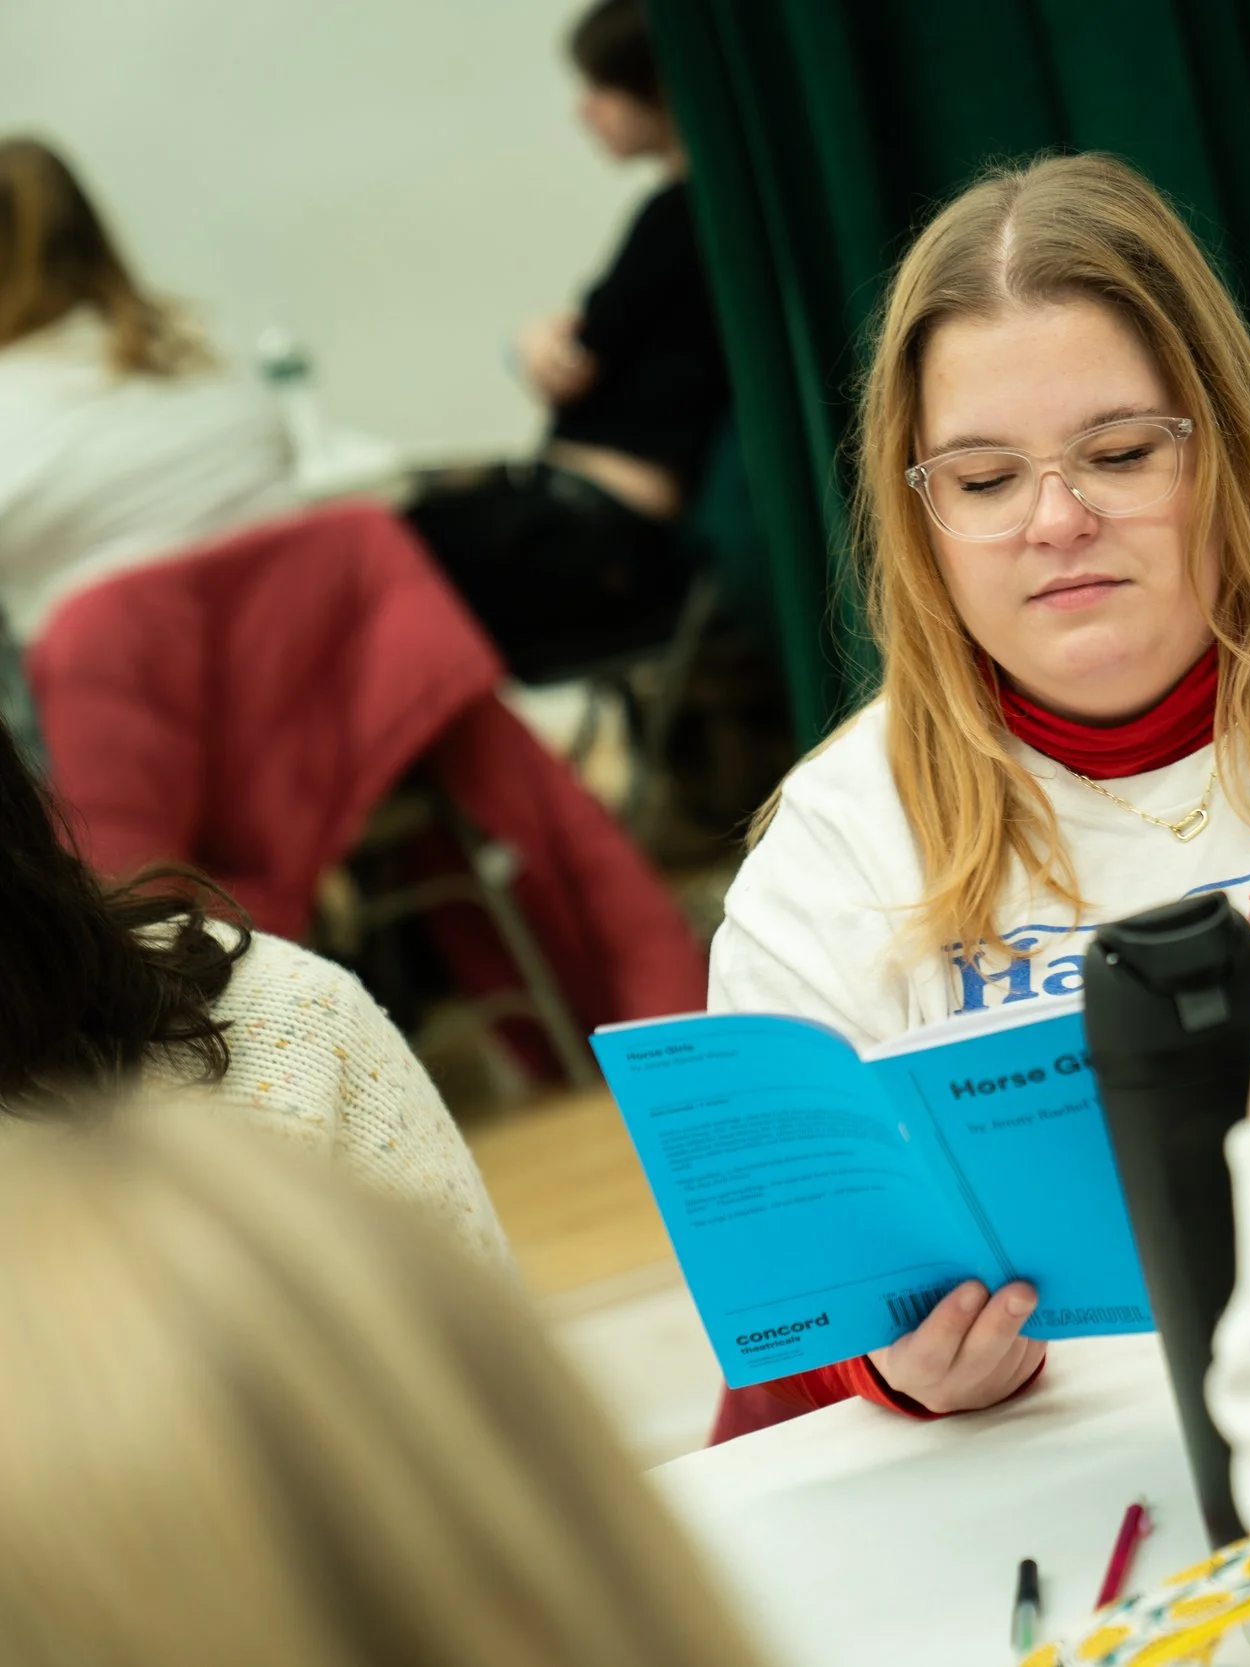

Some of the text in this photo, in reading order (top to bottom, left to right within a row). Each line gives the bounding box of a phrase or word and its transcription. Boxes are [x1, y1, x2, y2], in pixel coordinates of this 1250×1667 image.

[952, 937, 1085, 1015] Ha
[949, 1051, 1093, 1100] Horse Gi
[736, 1311, 830, 1346] concord
